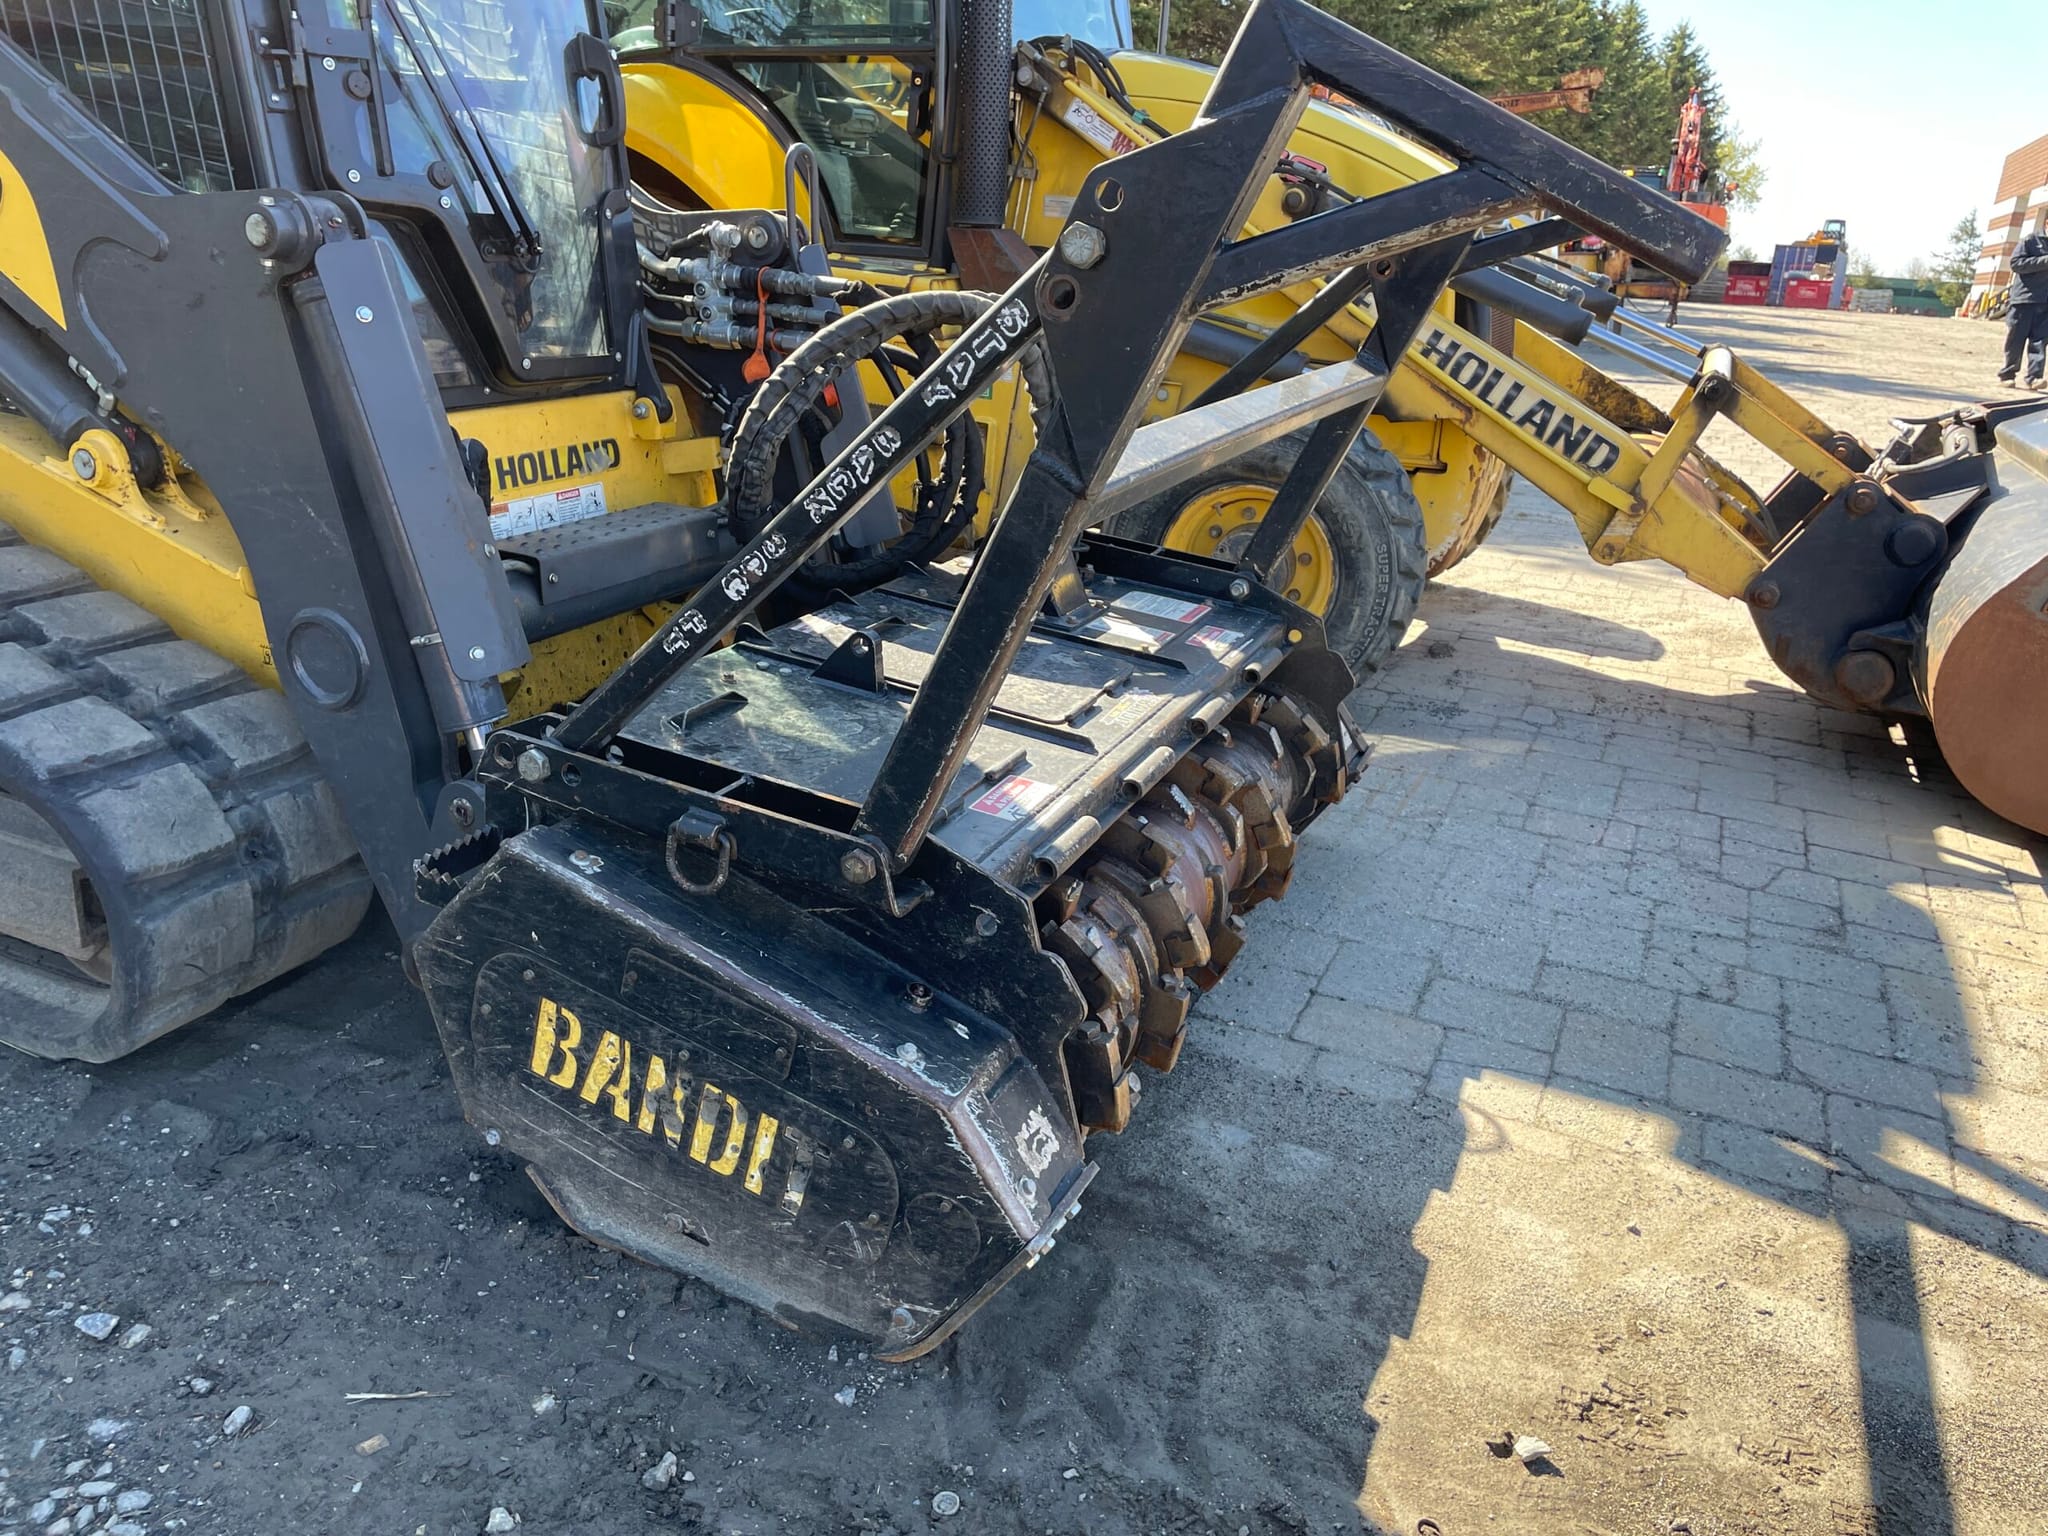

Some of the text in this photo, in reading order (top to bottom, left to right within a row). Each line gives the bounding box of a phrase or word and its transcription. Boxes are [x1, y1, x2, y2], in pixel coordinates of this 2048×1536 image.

[1420, 328, 1620, 475] HOLLAND
[494, 438, 620, 491] HOLLAND
[1376, 543, 1389, 593] SUPER
[530, 997, 832, 1217] BANDIT
